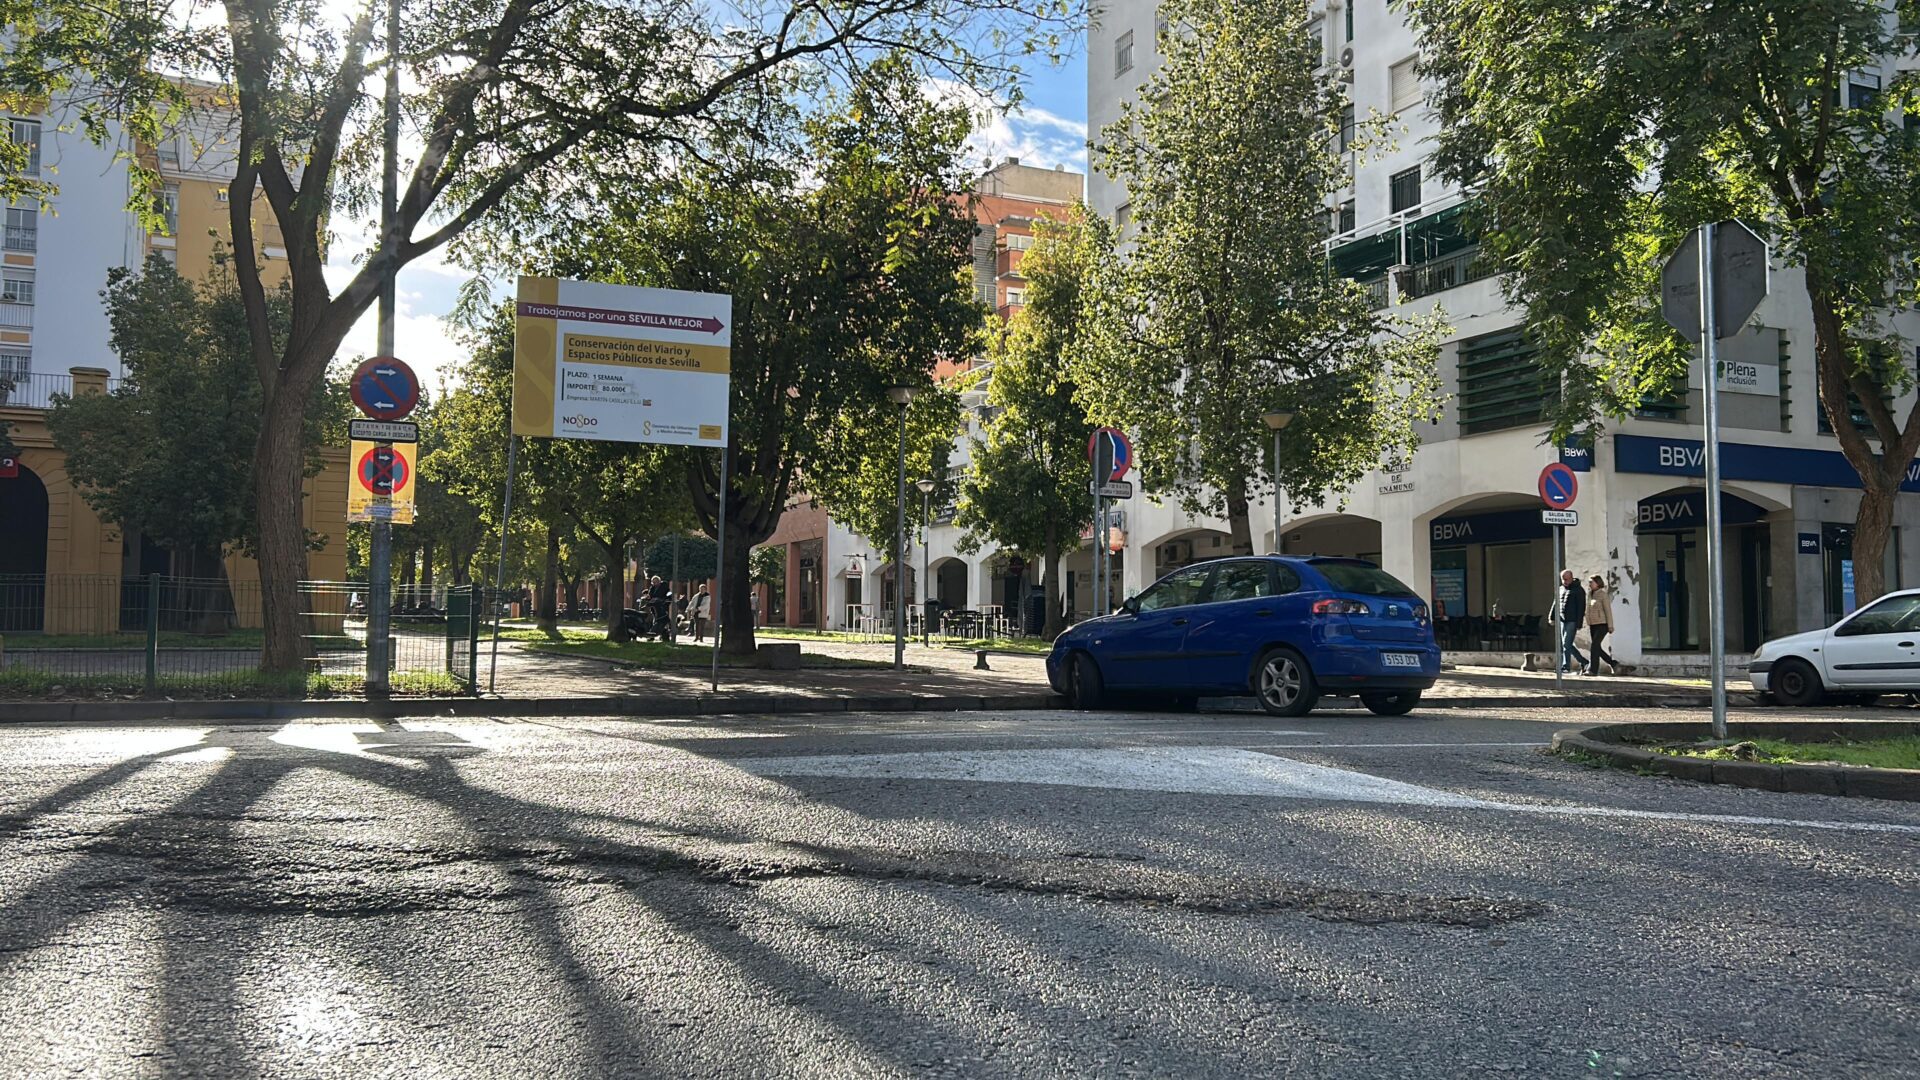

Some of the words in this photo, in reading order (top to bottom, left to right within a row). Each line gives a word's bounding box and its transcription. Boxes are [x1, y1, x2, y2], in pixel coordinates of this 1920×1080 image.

[527, 305, 586, 318] Trabajamos
[588, 312, 605, 320] por
[607, 314, 626, 322] una
[628, 314, 666, 326] SEVILLA
[668, 318, 702, 328] MEJOR
[568, 338, 634, 351] Conservación
[637, 344, 652, 352] del
[654, 344, 682, 355] Viario
[685, 348, 690, 358] y
[568, 350, 610, 360] Espacios
[612, 352, 653, 364] Públicos
[655, 356, 667, 366] de
[669, 358, 700, 368] Sevilla
[1726, 362, 1756, 376] Plena
[1726, 376, 1756, 386] inclusión
[1564, 448, 1588, 457] BBVA
[1391, 474, 1400, 482] DE
[1378, 483, 1413, 493] UNAMUNO
[1639, 500, 1692, 523] BBVA
[1434, 521, 1472, 540] BBVA
[1386, 654, 1404, 665] 5153
